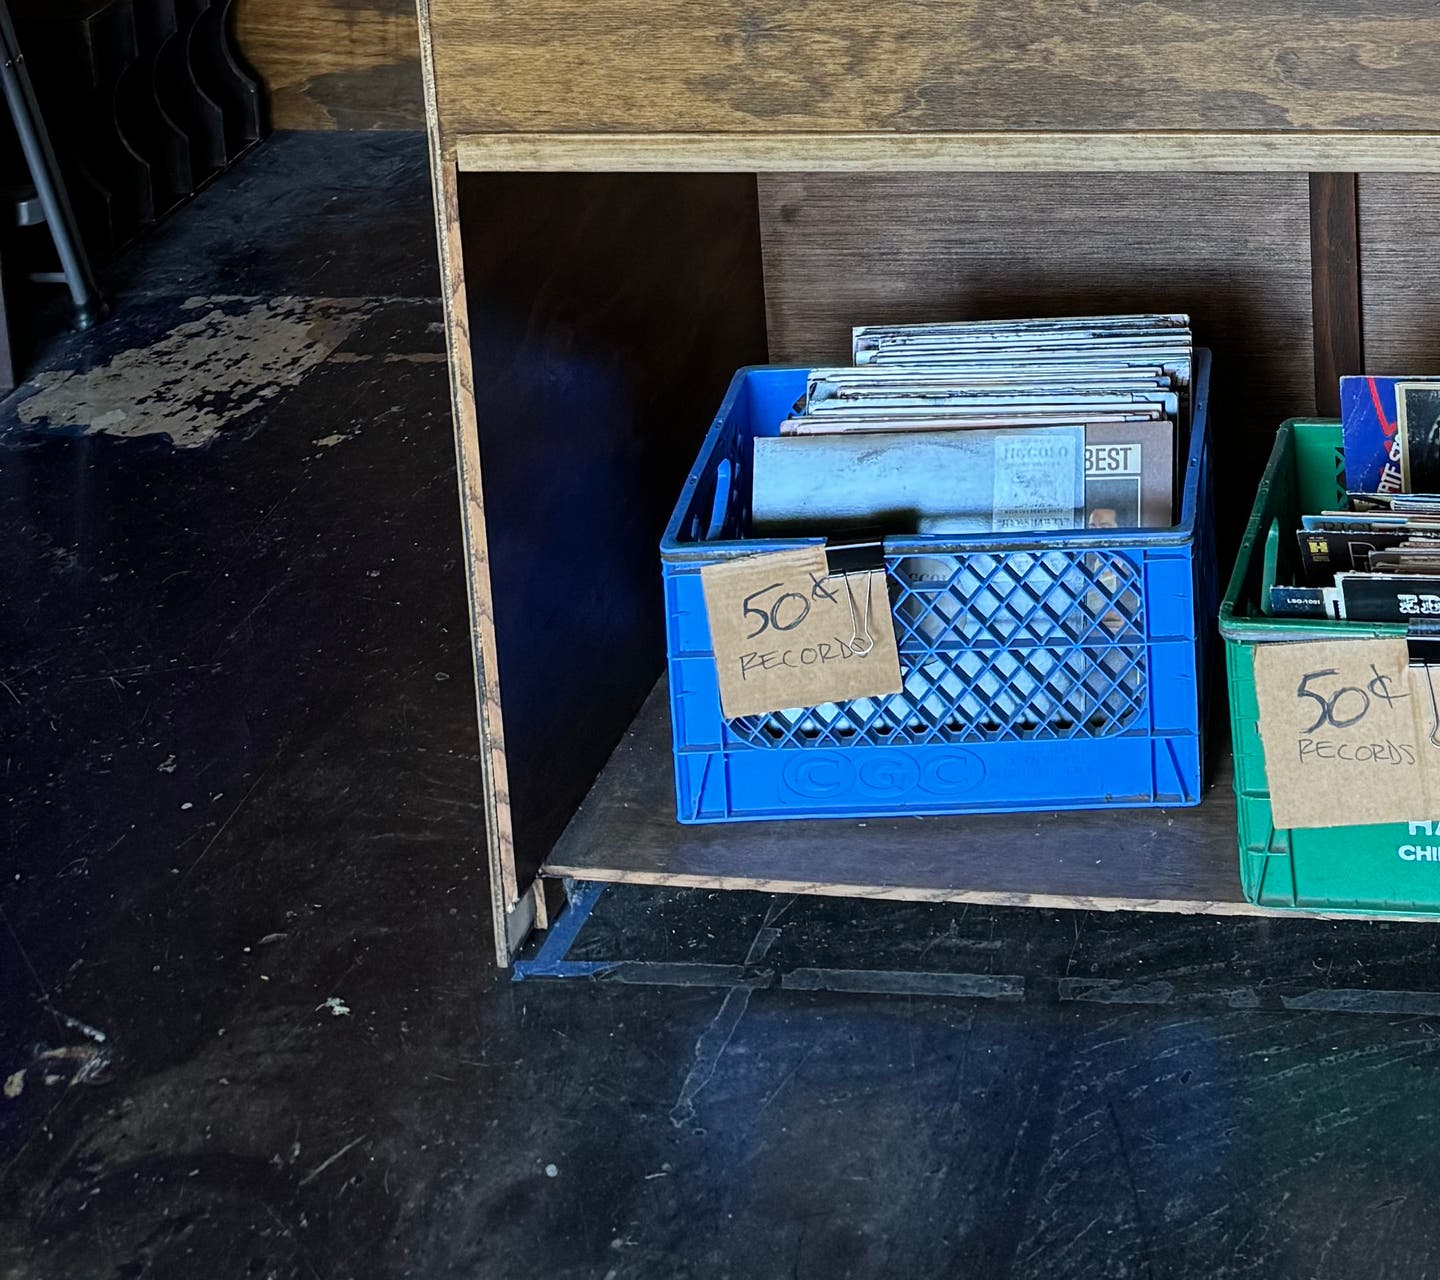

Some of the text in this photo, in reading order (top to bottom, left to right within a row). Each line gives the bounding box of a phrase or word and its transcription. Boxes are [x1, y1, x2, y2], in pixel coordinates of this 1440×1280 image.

[1085, 446, 1132, 472] BEST
[743, 571, 839, 640] 50¢
[739, 636, 872, 681] RECORDS
[1297, 663, 1411, 735] 50¢
[1297, 738, 1416, 766] RECORDS
